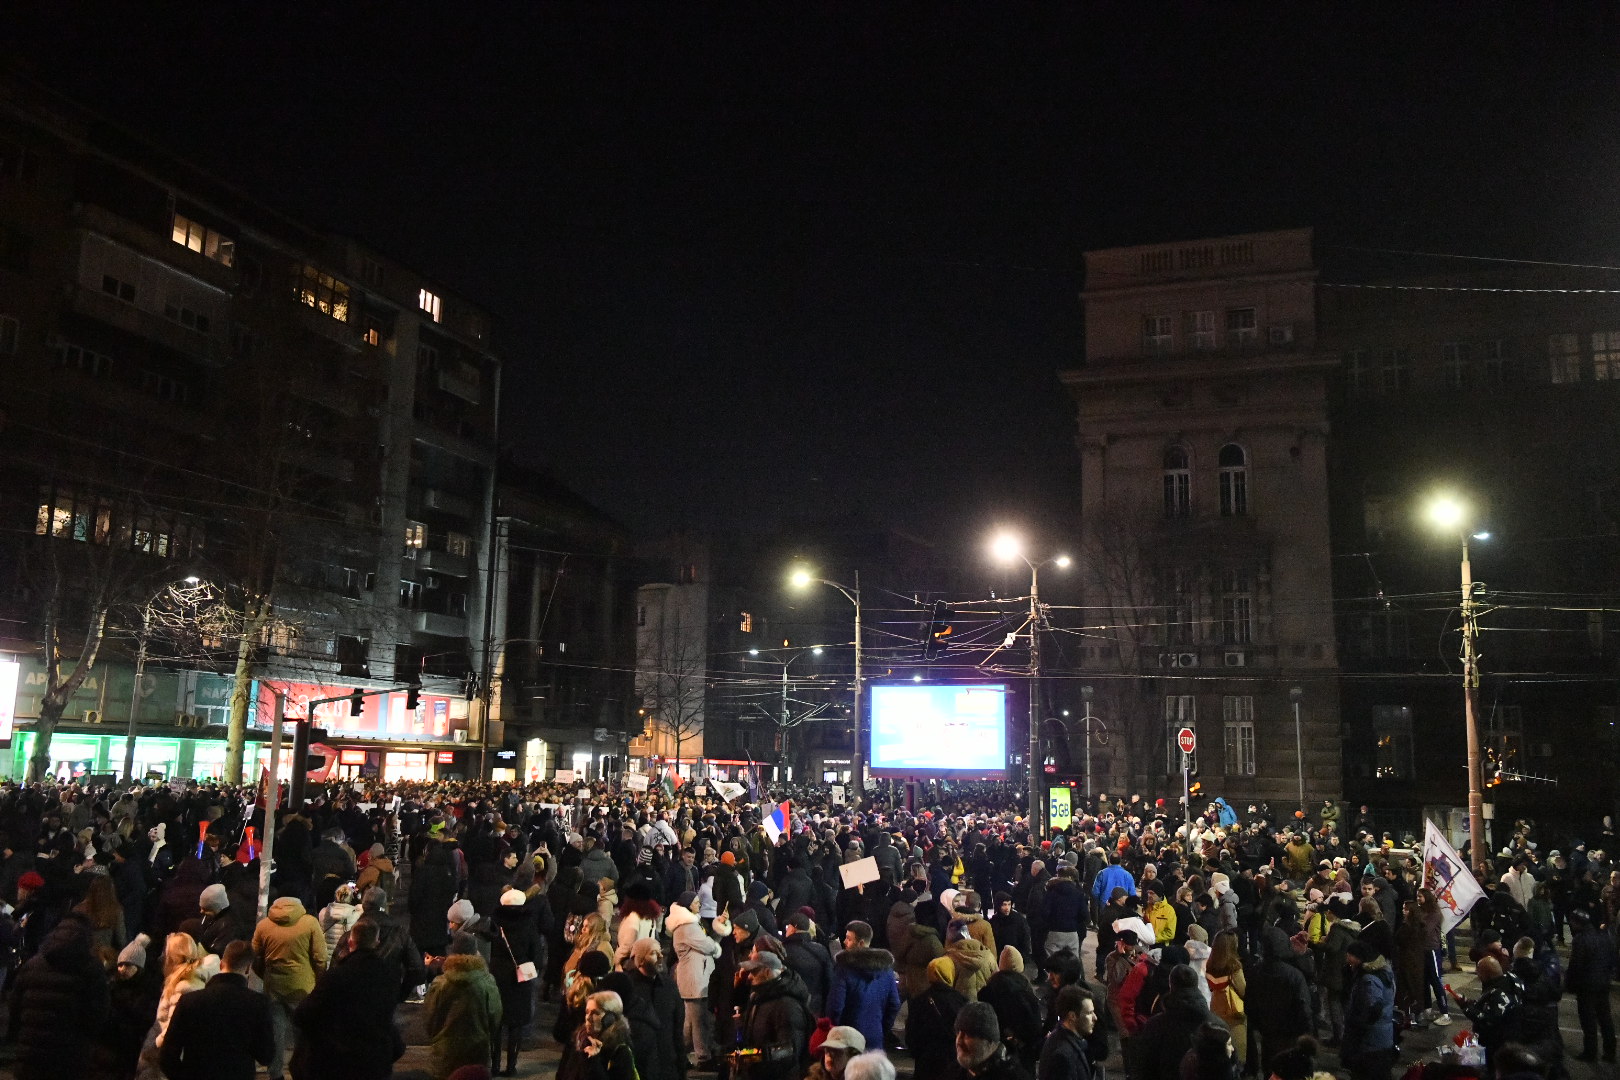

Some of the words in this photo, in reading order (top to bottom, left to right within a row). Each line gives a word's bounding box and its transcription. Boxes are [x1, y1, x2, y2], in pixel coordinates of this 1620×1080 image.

[25, 672, 98, 689] APTA
[283, 688, 364, 721] Lagun
[1180, 736, 1194, 745] STOP
